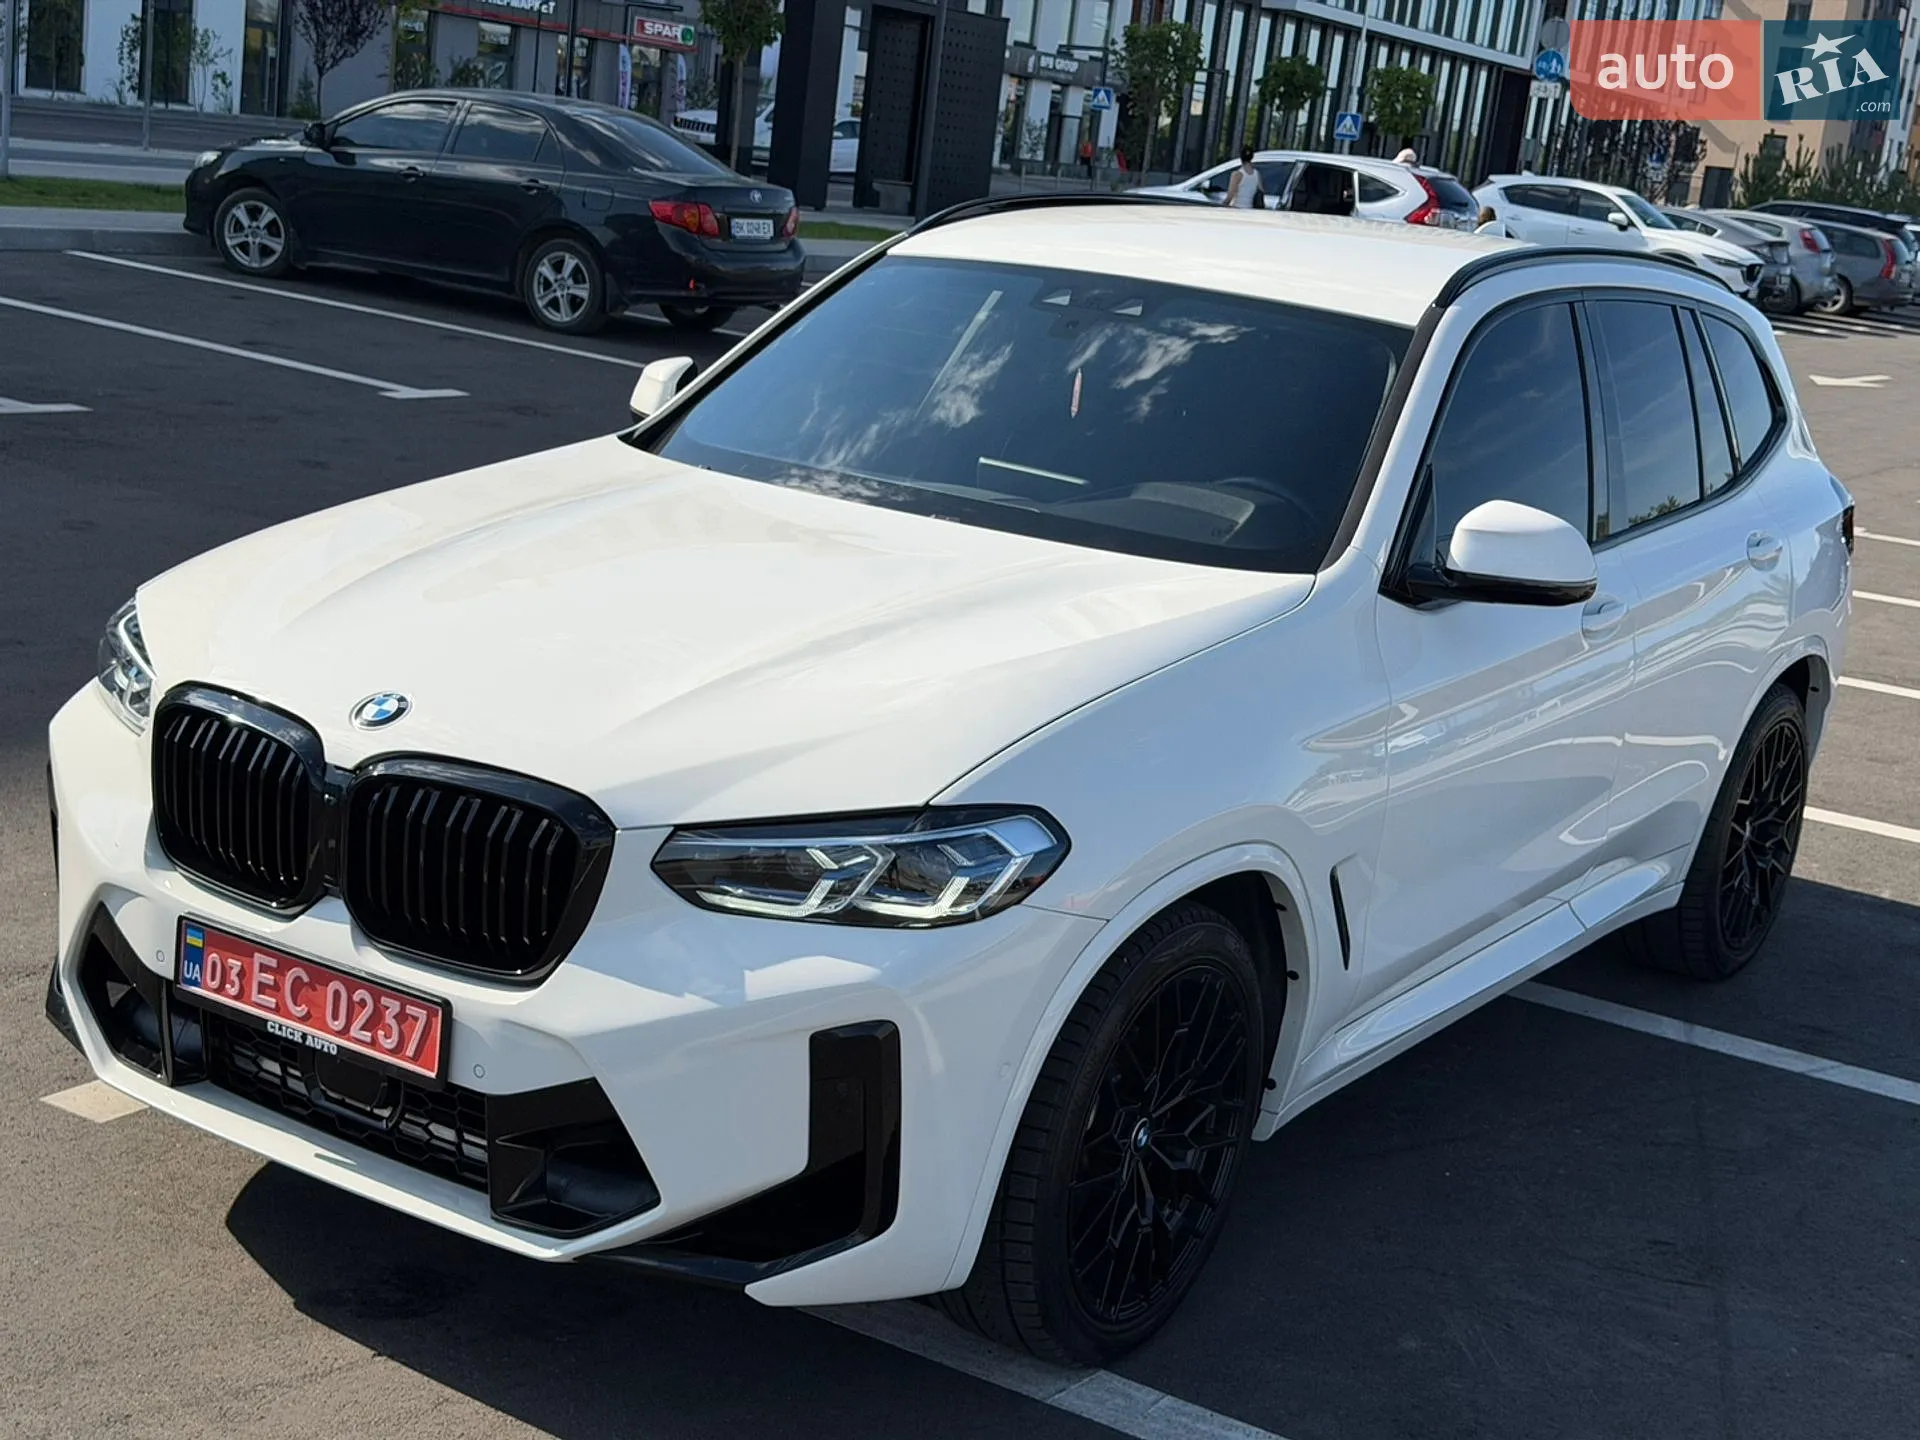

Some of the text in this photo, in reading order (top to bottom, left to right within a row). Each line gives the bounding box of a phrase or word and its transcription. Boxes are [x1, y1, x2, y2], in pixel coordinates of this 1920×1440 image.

[643, 22, 681, 41] SPAR
[1055, 58, 1079, 73] GROUP
[183, 959, 201, 983] UA
[206, 952, 428, 1059] 03 EC 0237
[266, 1021, 338, 1056] CLICK AUTO
